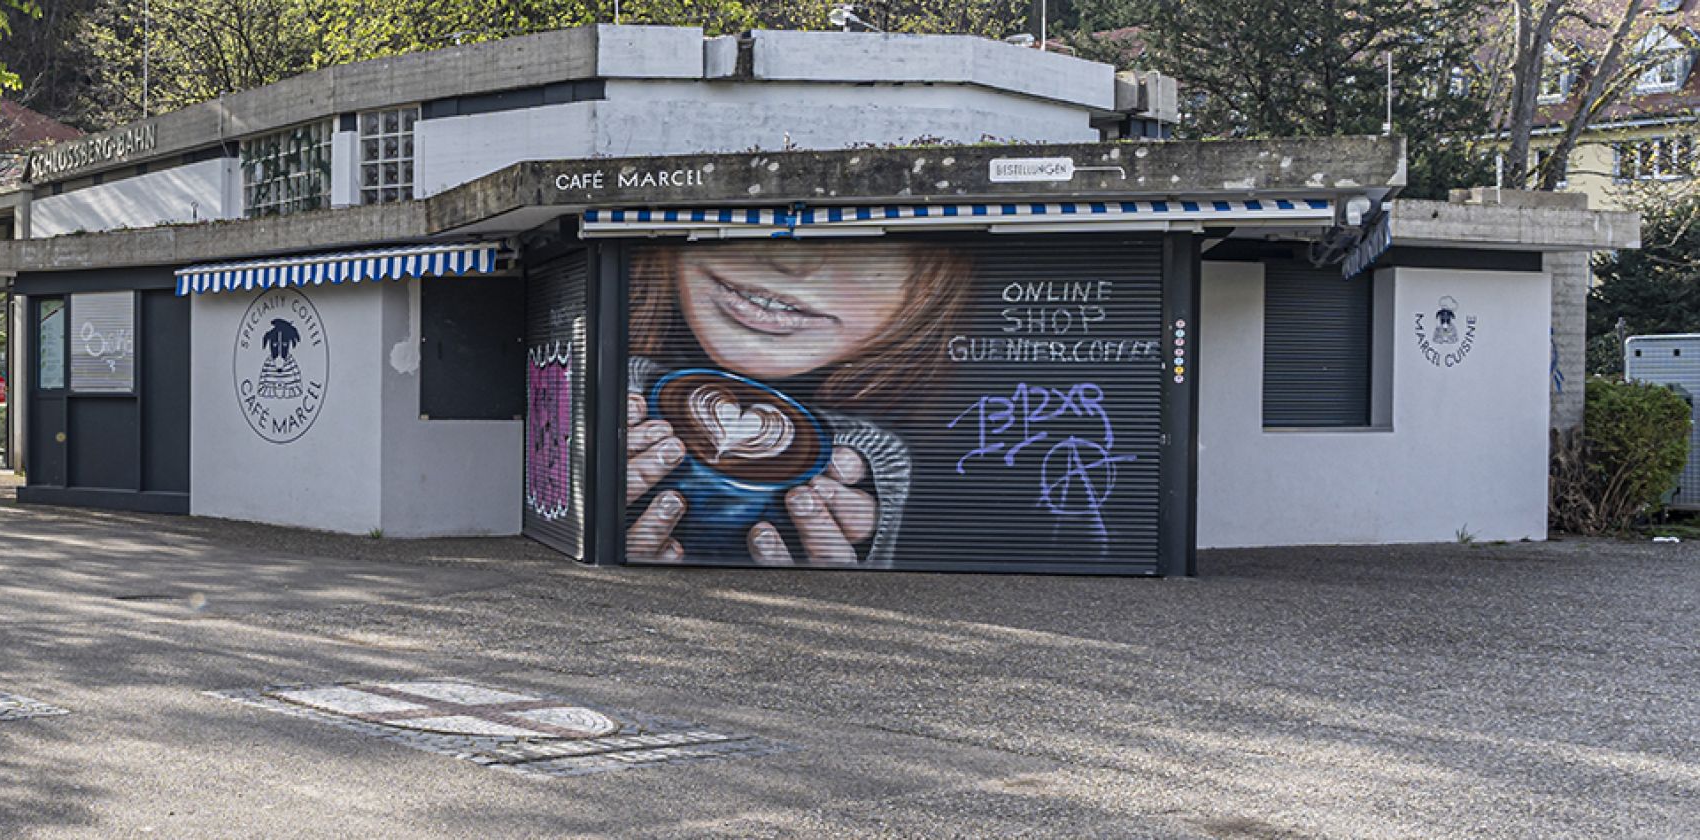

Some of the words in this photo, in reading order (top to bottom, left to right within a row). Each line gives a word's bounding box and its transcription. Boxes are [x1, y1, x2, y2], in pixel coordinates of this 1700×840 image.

[555, 169, 604, 191] CAFÉ
[617, 169, 703, 188] MARCEL
[996, 163, 1067, 176] BESTELLUNGEN
[1002, 281, 1113, 302] ONLINE
[241, 295, 286, 350] SPECIALTY
[291, 299, 323, 347] COFFEE
[1002, 305, 1106, 334] SHOP
[1415, 313, 1440, 367] MARCEL
[1444, 315, 1476, 367] CUISINE
[240, 378, 270, 430] CAFÉ
[272, 380, 322, 435] MARCEL
